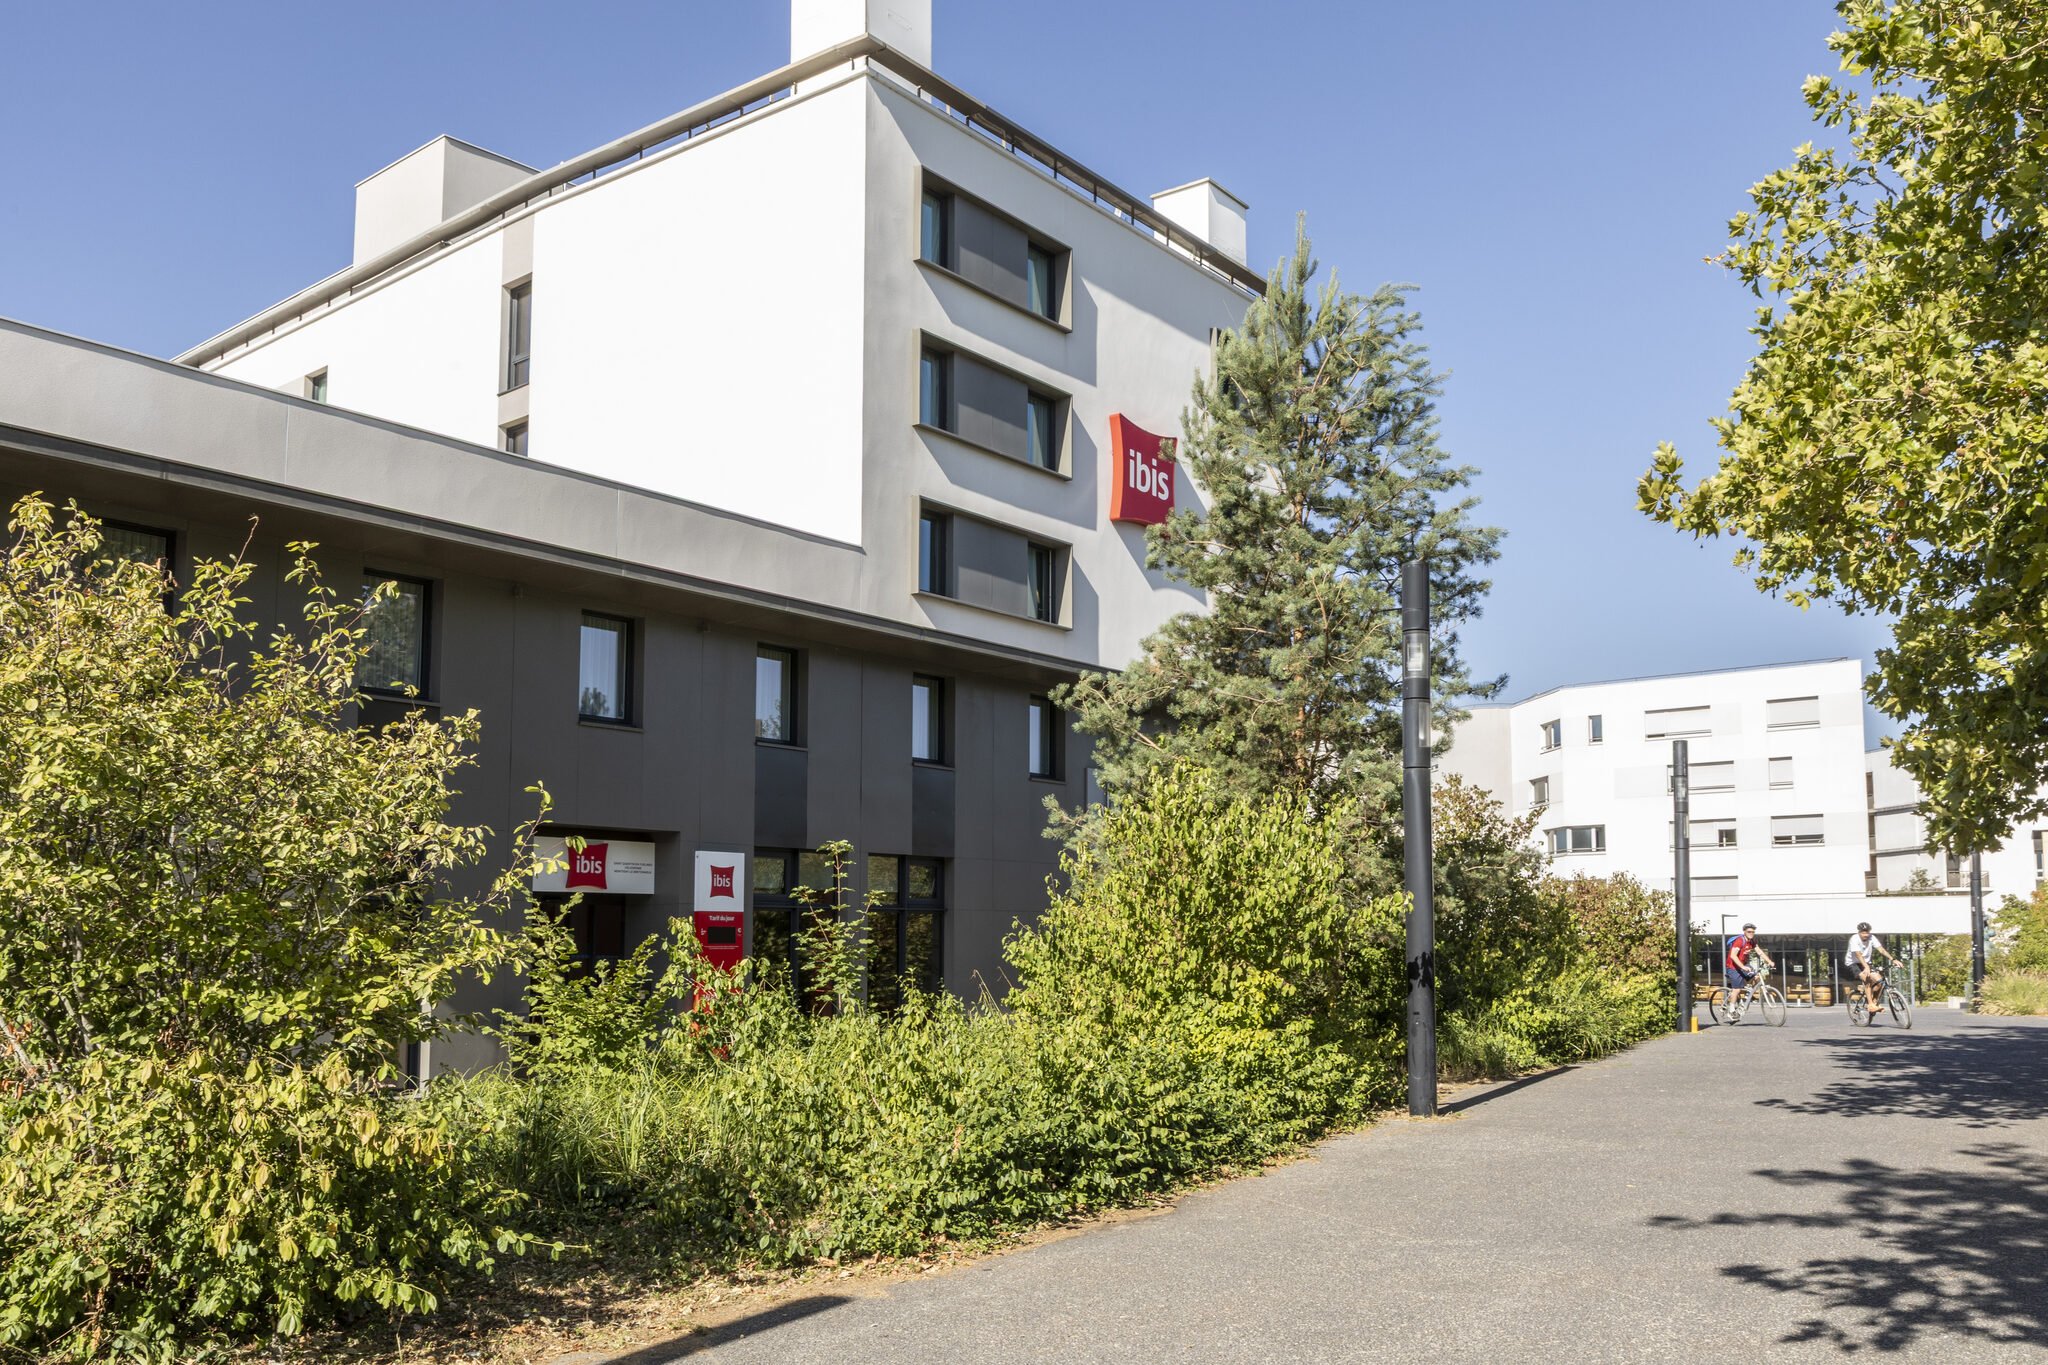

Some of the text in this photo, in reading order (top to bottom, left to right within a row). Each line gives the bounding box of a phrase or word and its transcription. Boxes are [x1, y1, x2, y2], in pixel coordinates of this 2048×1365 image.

[1129, 449, 1169, 500] ibis
[576, 856, 602, 874] ibis
[713, 874, 730, 887] ibis
